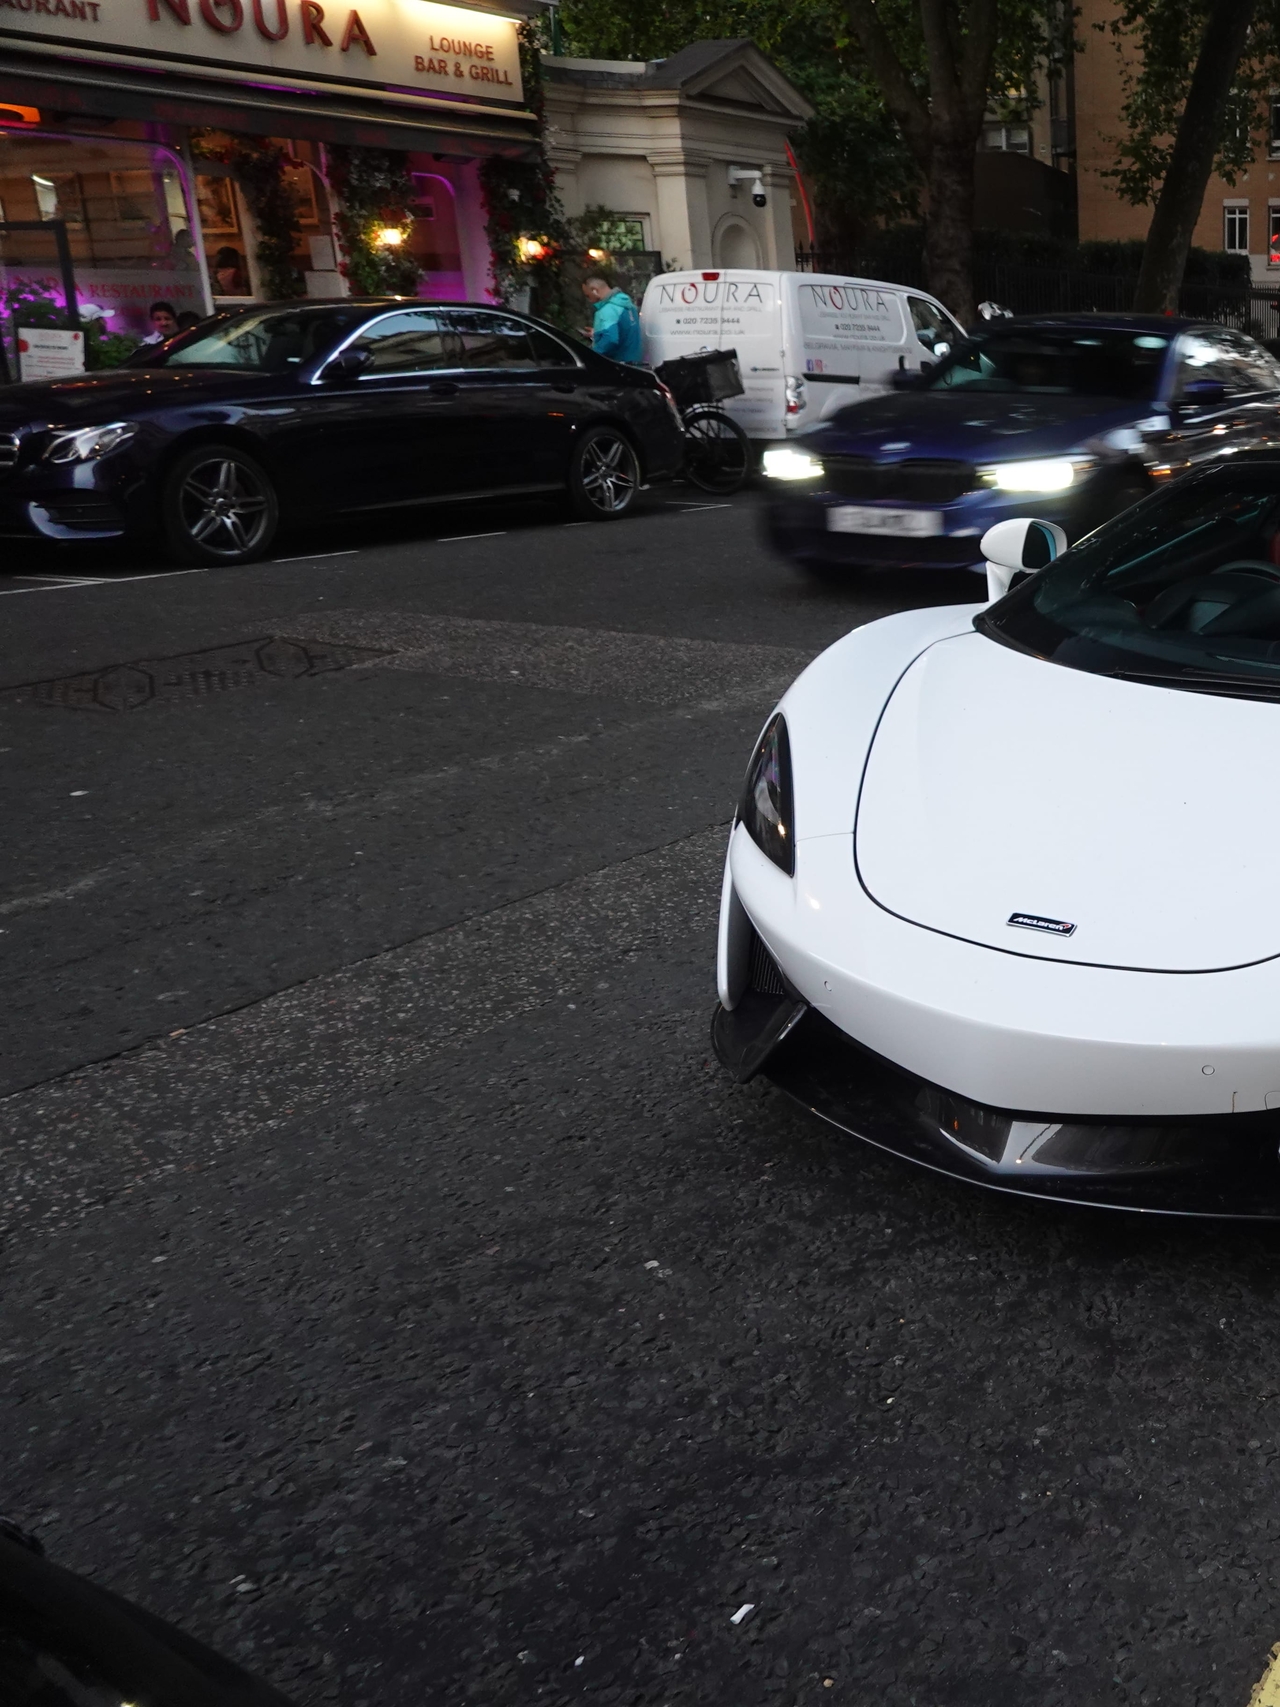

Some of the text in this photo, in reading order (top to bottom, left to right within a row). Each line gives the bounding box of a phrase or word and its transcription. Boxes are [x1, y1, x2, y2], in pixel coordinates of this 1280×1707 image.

[429, 34, 495, 62] LOUNGE
[414, 56, 514, 86] BAR & GRILL
[90, 283, 196, 299] RESTAURANT
[660, 283, 763, 304] NOURA
[810, 286, 889, 312] NOURA
[682, 317, 697, 325] 020
[1013, 917, 1064, 930] McLaren
